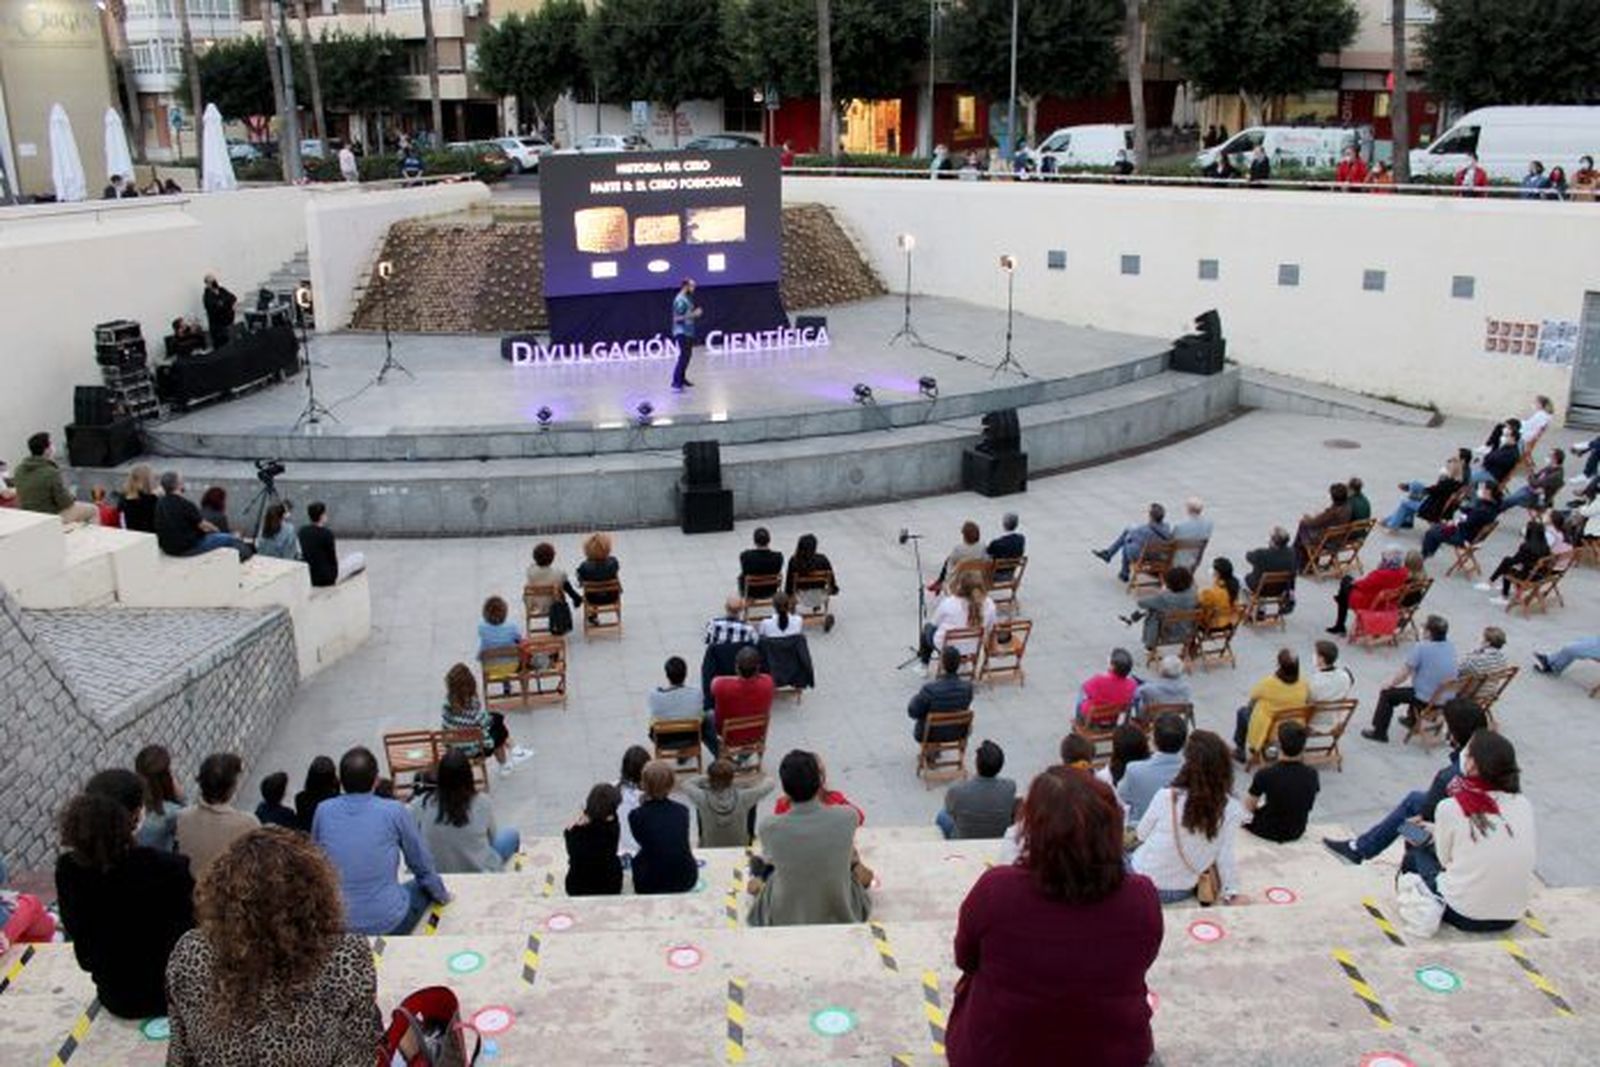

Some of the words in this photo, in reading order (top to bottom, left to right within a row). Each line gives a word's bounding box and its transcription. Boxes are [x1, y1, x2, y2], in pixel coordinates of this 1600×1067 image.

[616, 162, 663, 174] HISTORIA
[664, 161, 682, 172] DEL
[683, 160, 711, 172] CERO
[590, 181, 621, 194] PARTE
[648, 178, 678, 191] CERO
[680, 175, 743, 190] POSICIONAL
